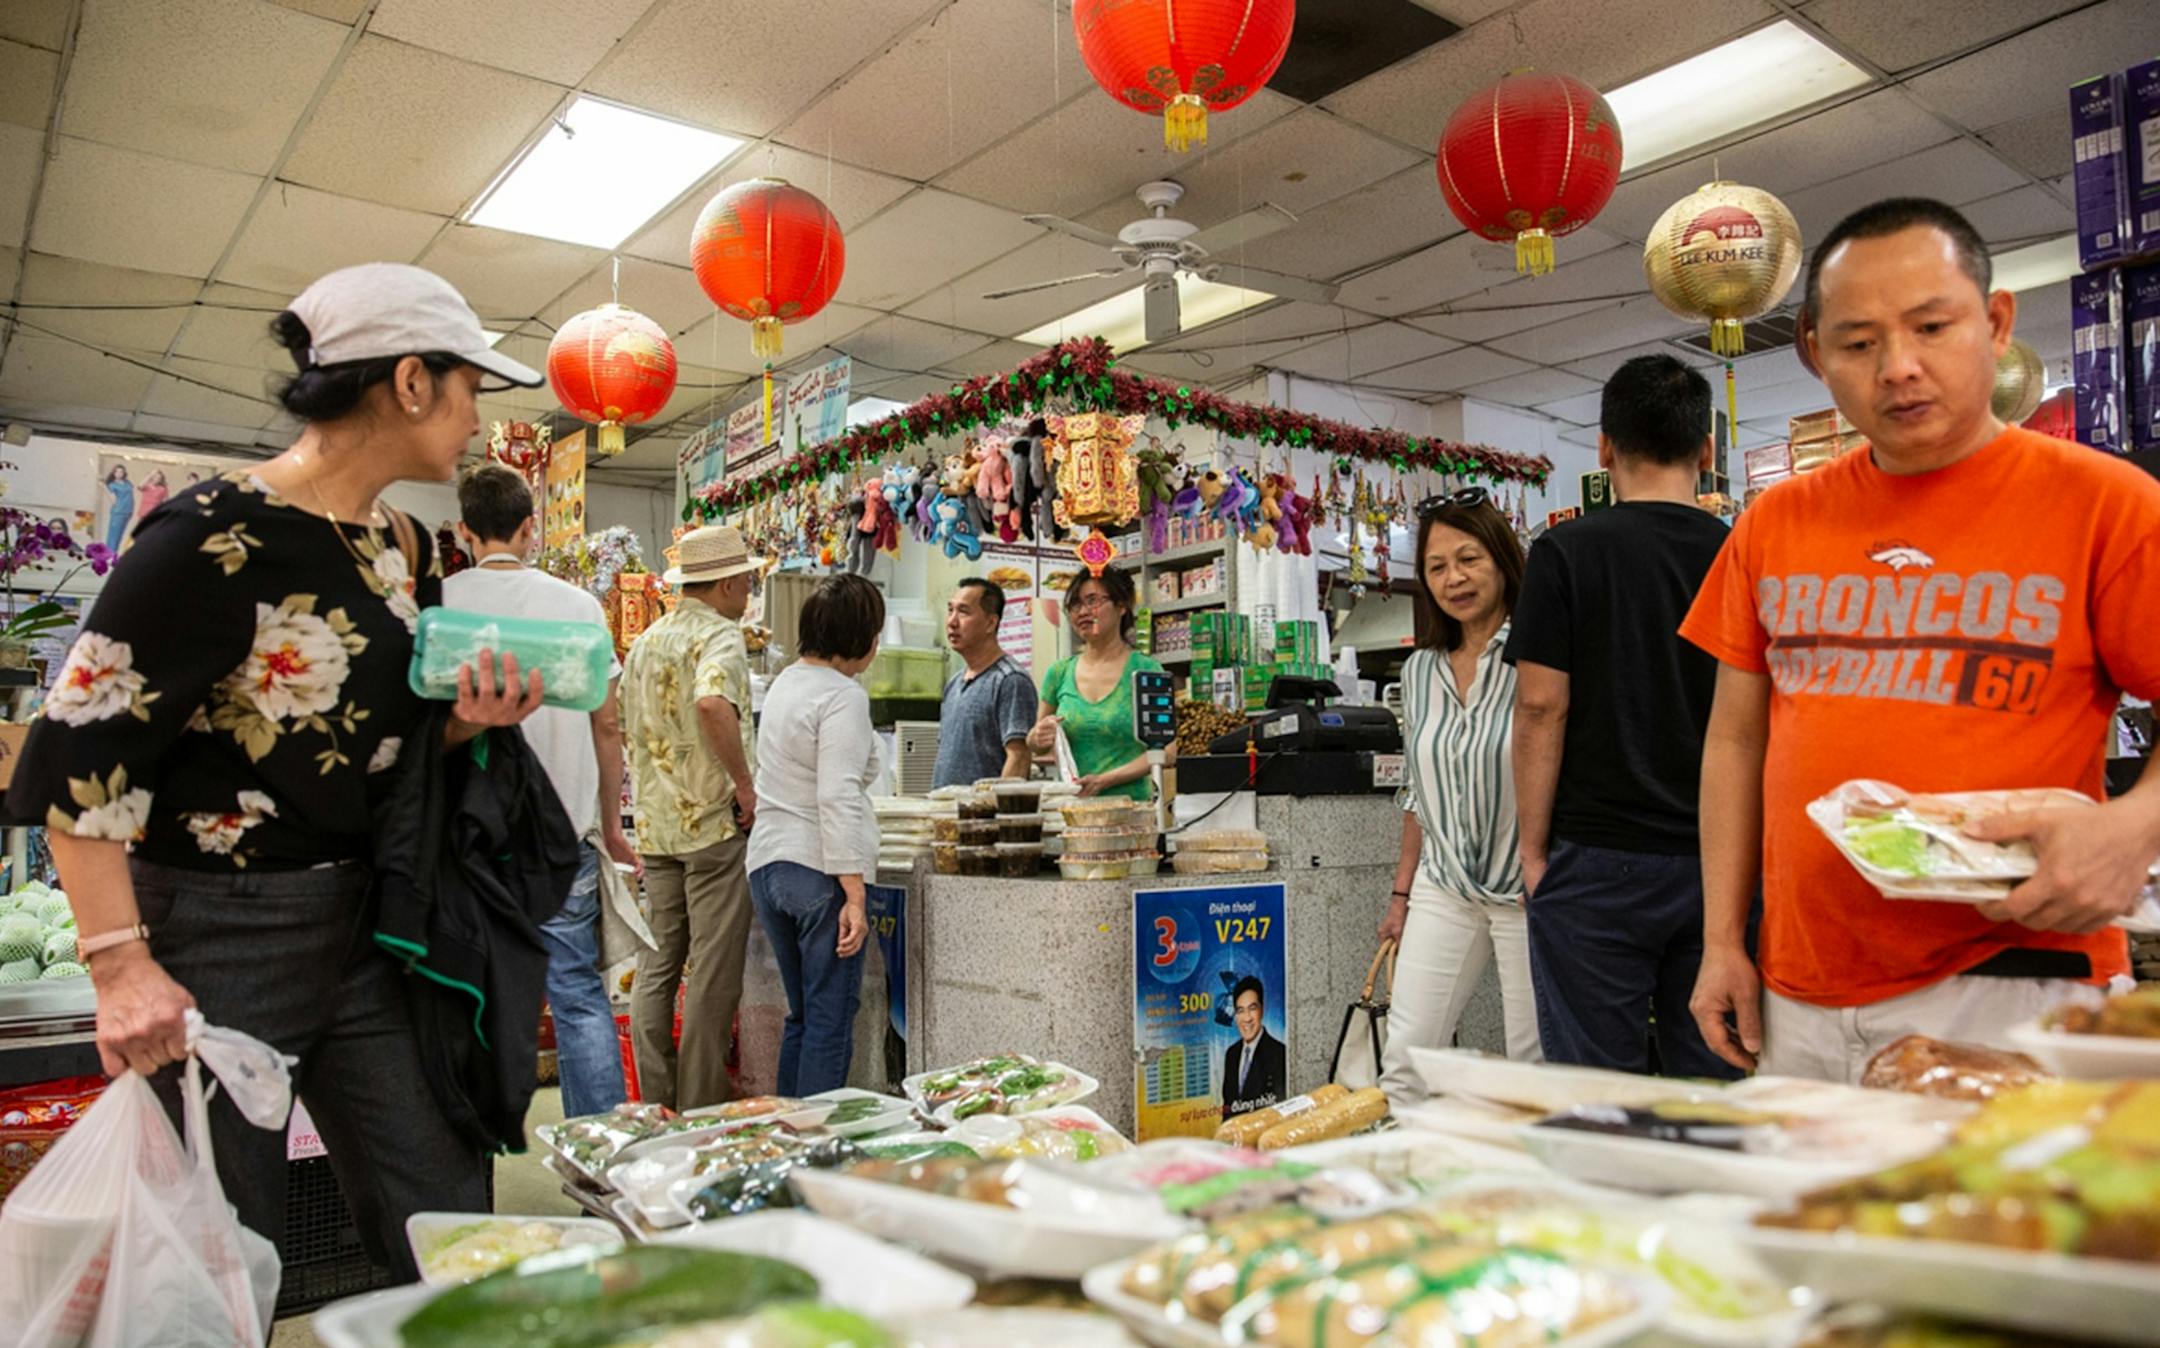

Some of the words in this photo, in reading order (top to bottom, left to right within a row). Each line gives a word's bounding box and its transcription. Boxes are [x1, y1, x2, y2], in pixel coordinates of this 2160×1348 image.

[1681, 253, 1699, 266] LEE
[1706, 248, 1736, 264] KUM
[1741, 247, 1765, 261] KEE
[1758, 571, 2066, 646] BRONCOS
[1972, 655, 2050, 713] 60
[1153, 915, 1179, 967] 3
[1215, 916, 1272, 944] V247
[1179, 992, 1210, 1014] 300
